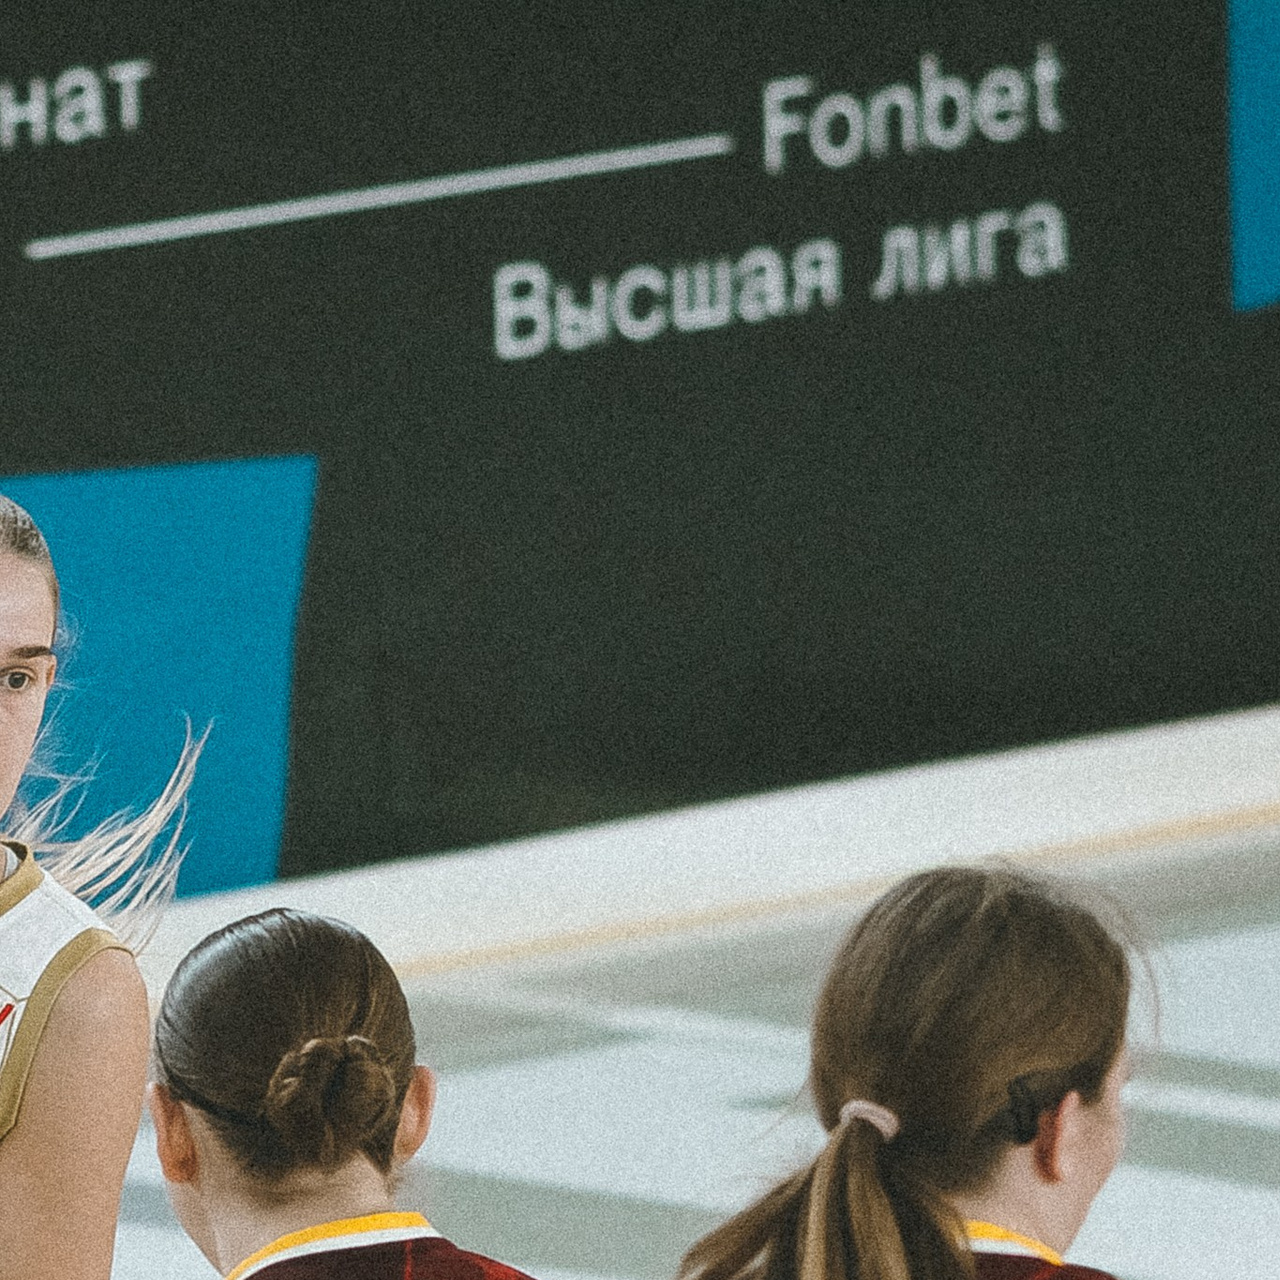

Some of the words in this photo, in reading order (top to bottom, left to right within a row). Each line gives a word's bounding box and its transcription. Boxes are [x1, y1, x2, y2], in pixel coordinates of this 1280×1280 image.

[763, 43, 1064, 175] Fonbet
[494, 236, 843, 362] Высшая
[870, 201, 1070, 302] лига
